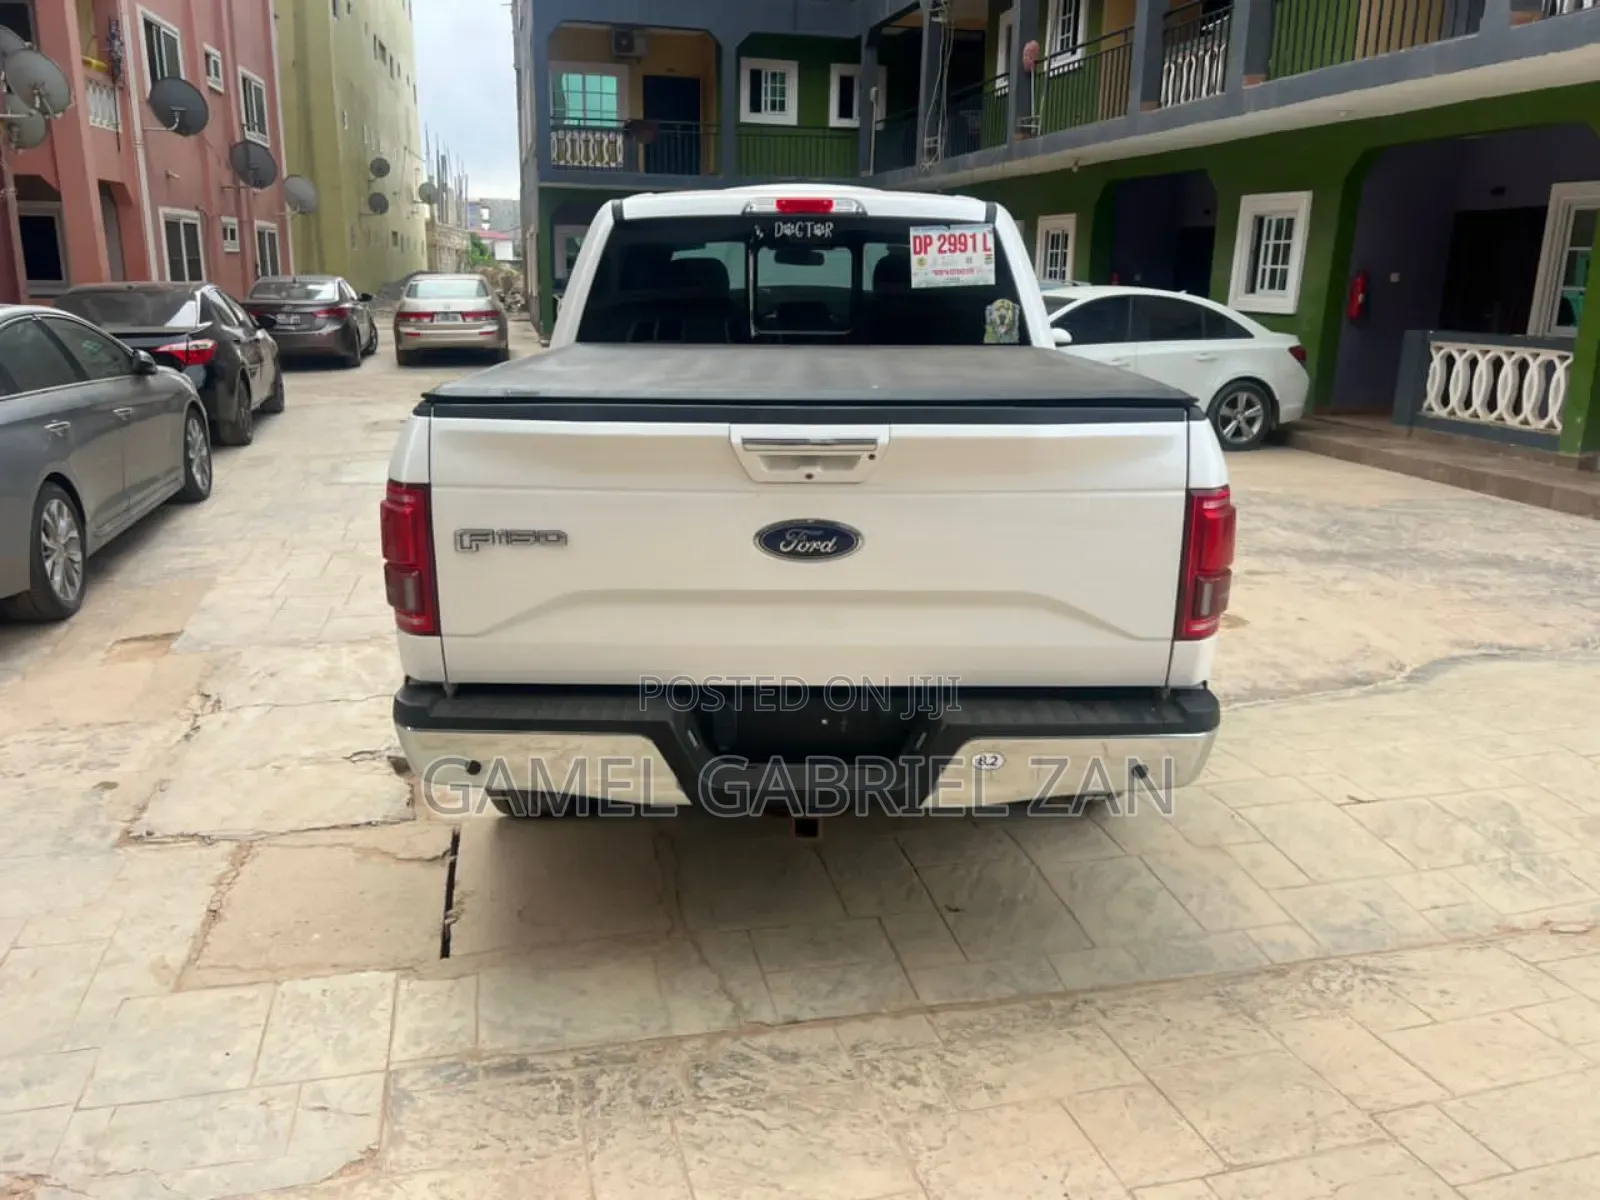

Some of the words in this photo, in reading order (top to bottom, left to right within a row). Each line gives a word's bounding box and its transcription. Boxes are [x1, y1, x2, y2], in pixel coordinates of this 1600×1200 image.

[913, 234, 933, 255] DP
[937, 232, 977, 254] 2991
[982, 232, 992, 252] L
[779, 528, 838, 553] Ford
